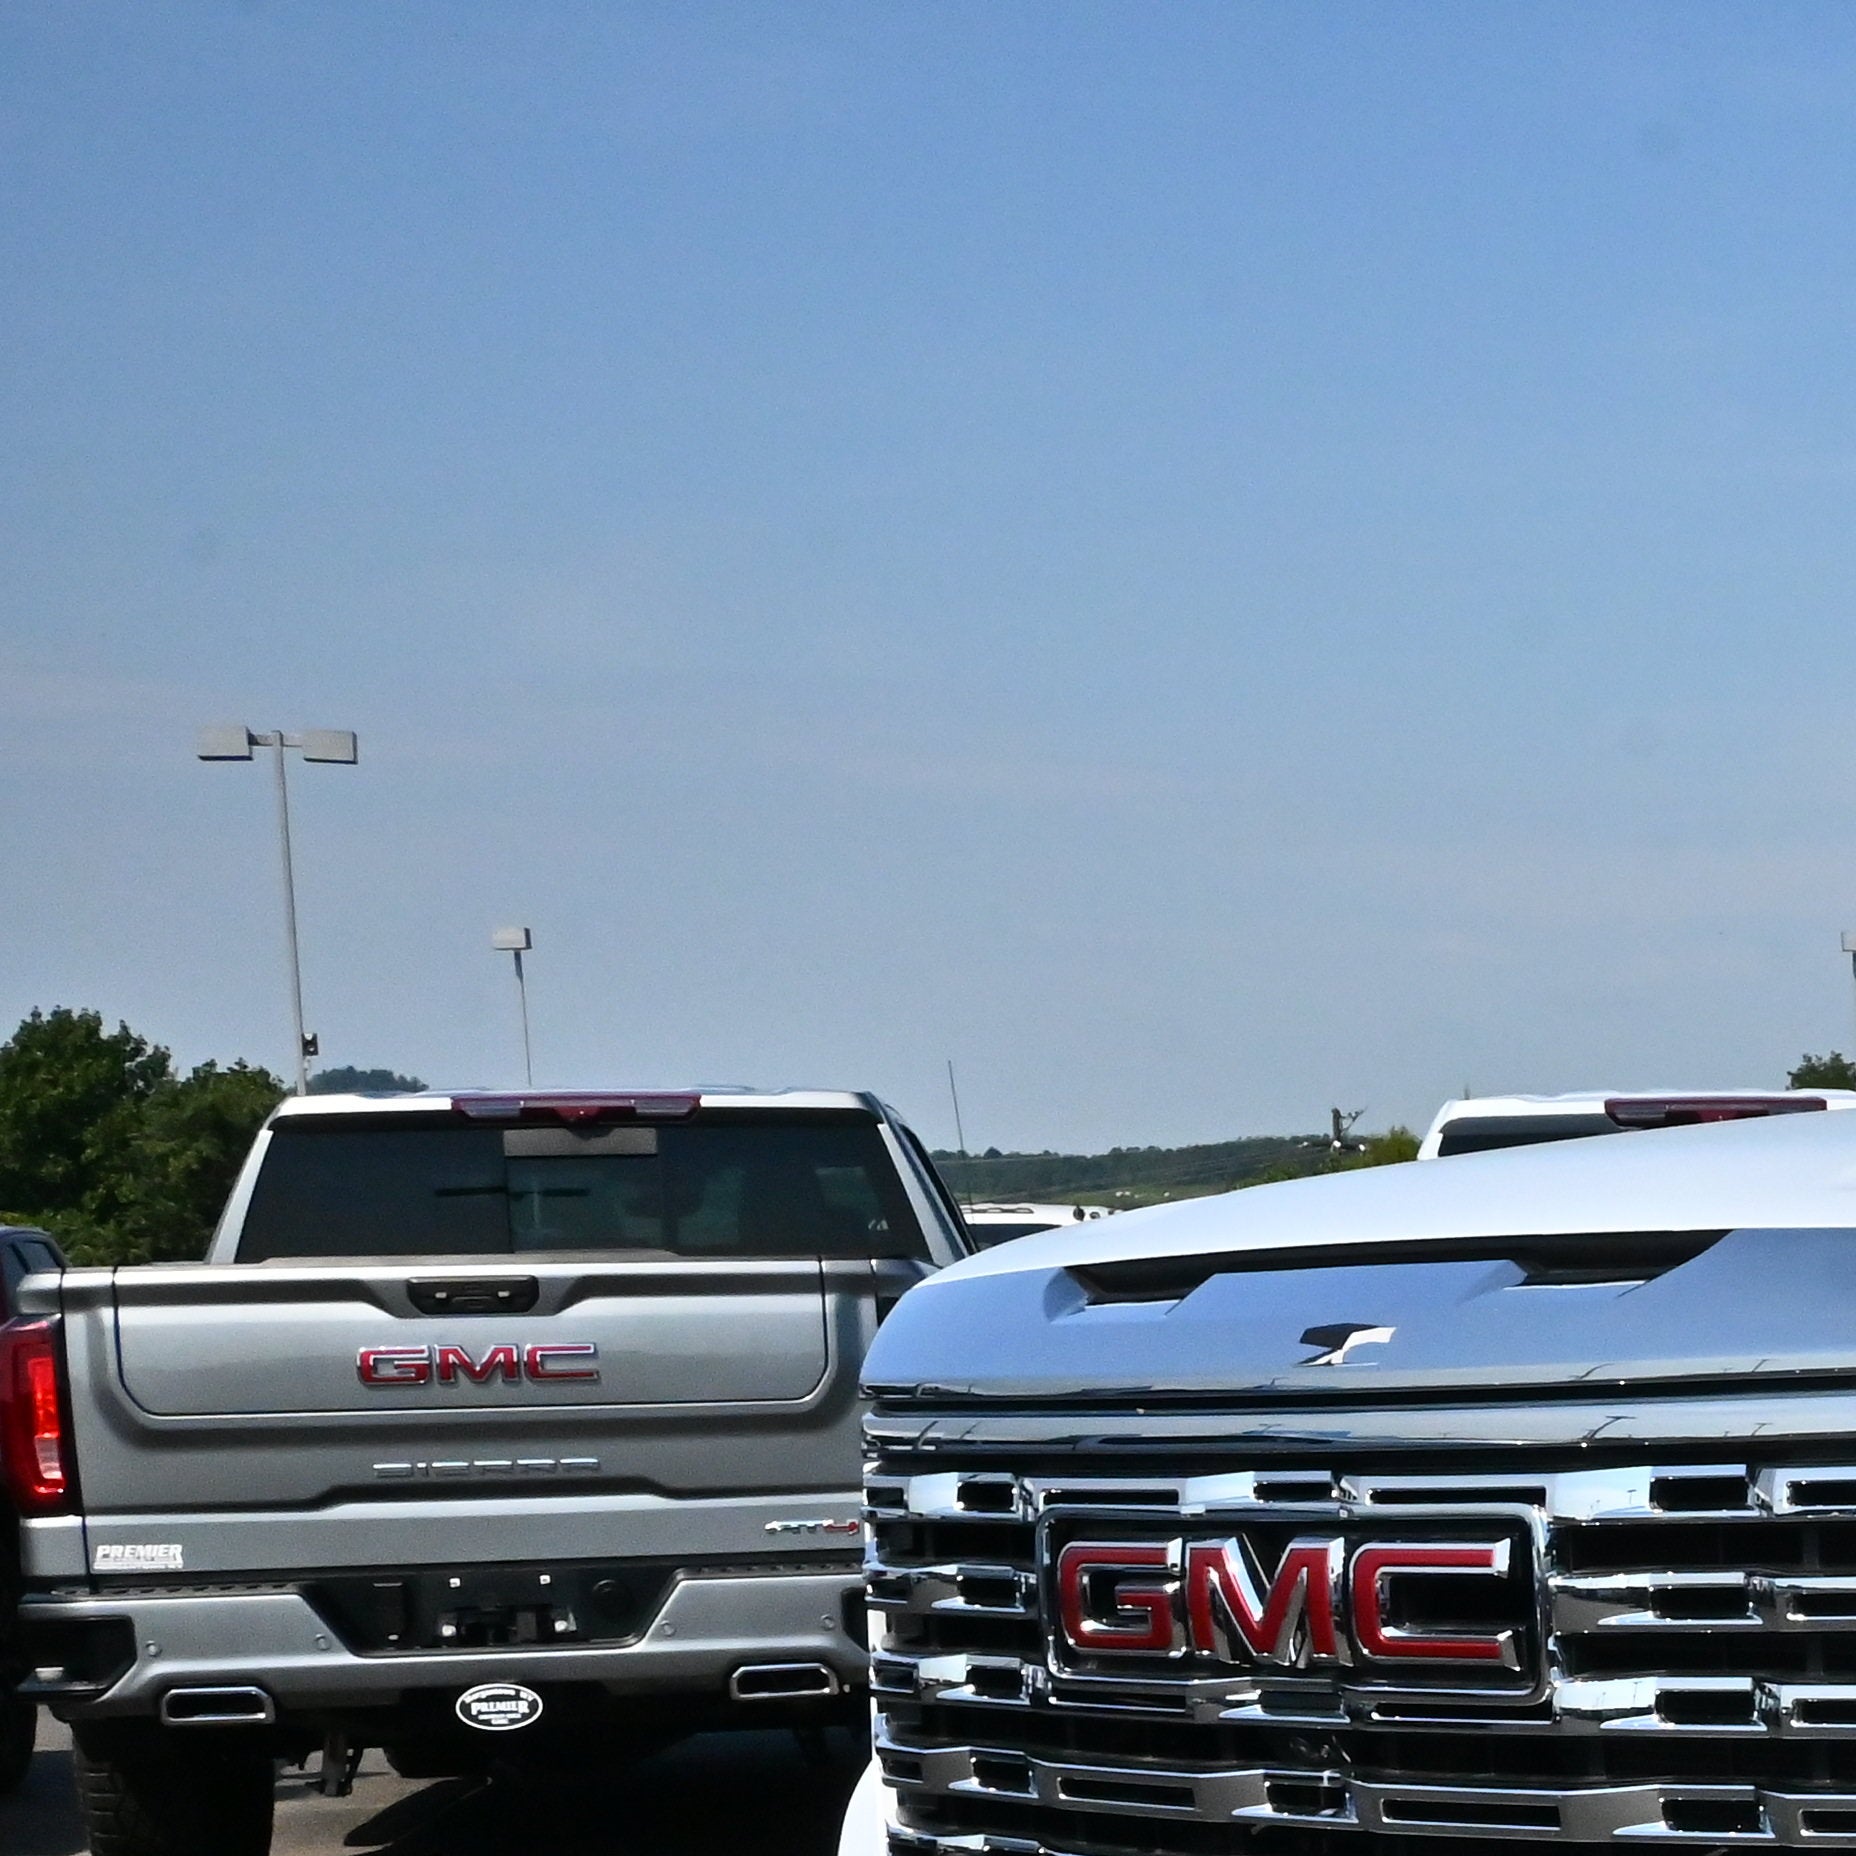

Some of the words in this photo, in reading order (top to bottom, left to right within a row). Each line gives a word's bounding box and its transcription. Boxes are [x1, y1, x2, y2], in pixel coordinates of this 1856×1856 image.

[357, 1343, 601, 1386] GMC
[95, 1543, 183, 1561] PREMIER
[1057, 1536, 1522, 1672] GMC
